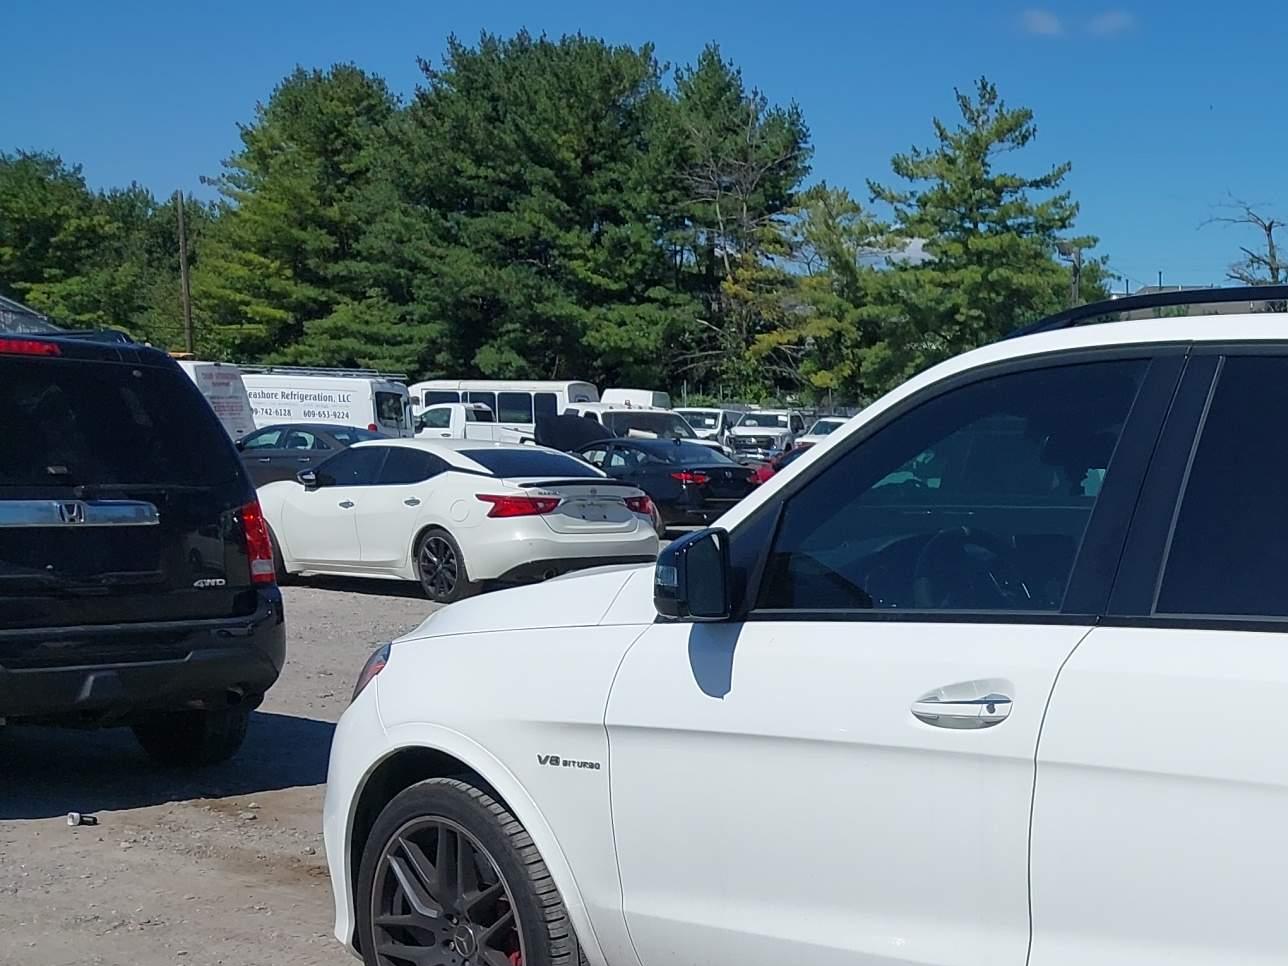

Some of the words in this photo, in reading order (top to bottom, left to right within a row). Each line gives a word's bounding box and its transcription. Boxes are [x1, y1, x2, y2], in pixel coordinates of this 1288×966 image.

[248, 389, 279, 399] eashore
[338, 393, 352, 402] LLC
[193, 578, 226, 588] 4WD
[536, 753, 561, 766] V8
[562, 759, 601, 770] BITURBO
